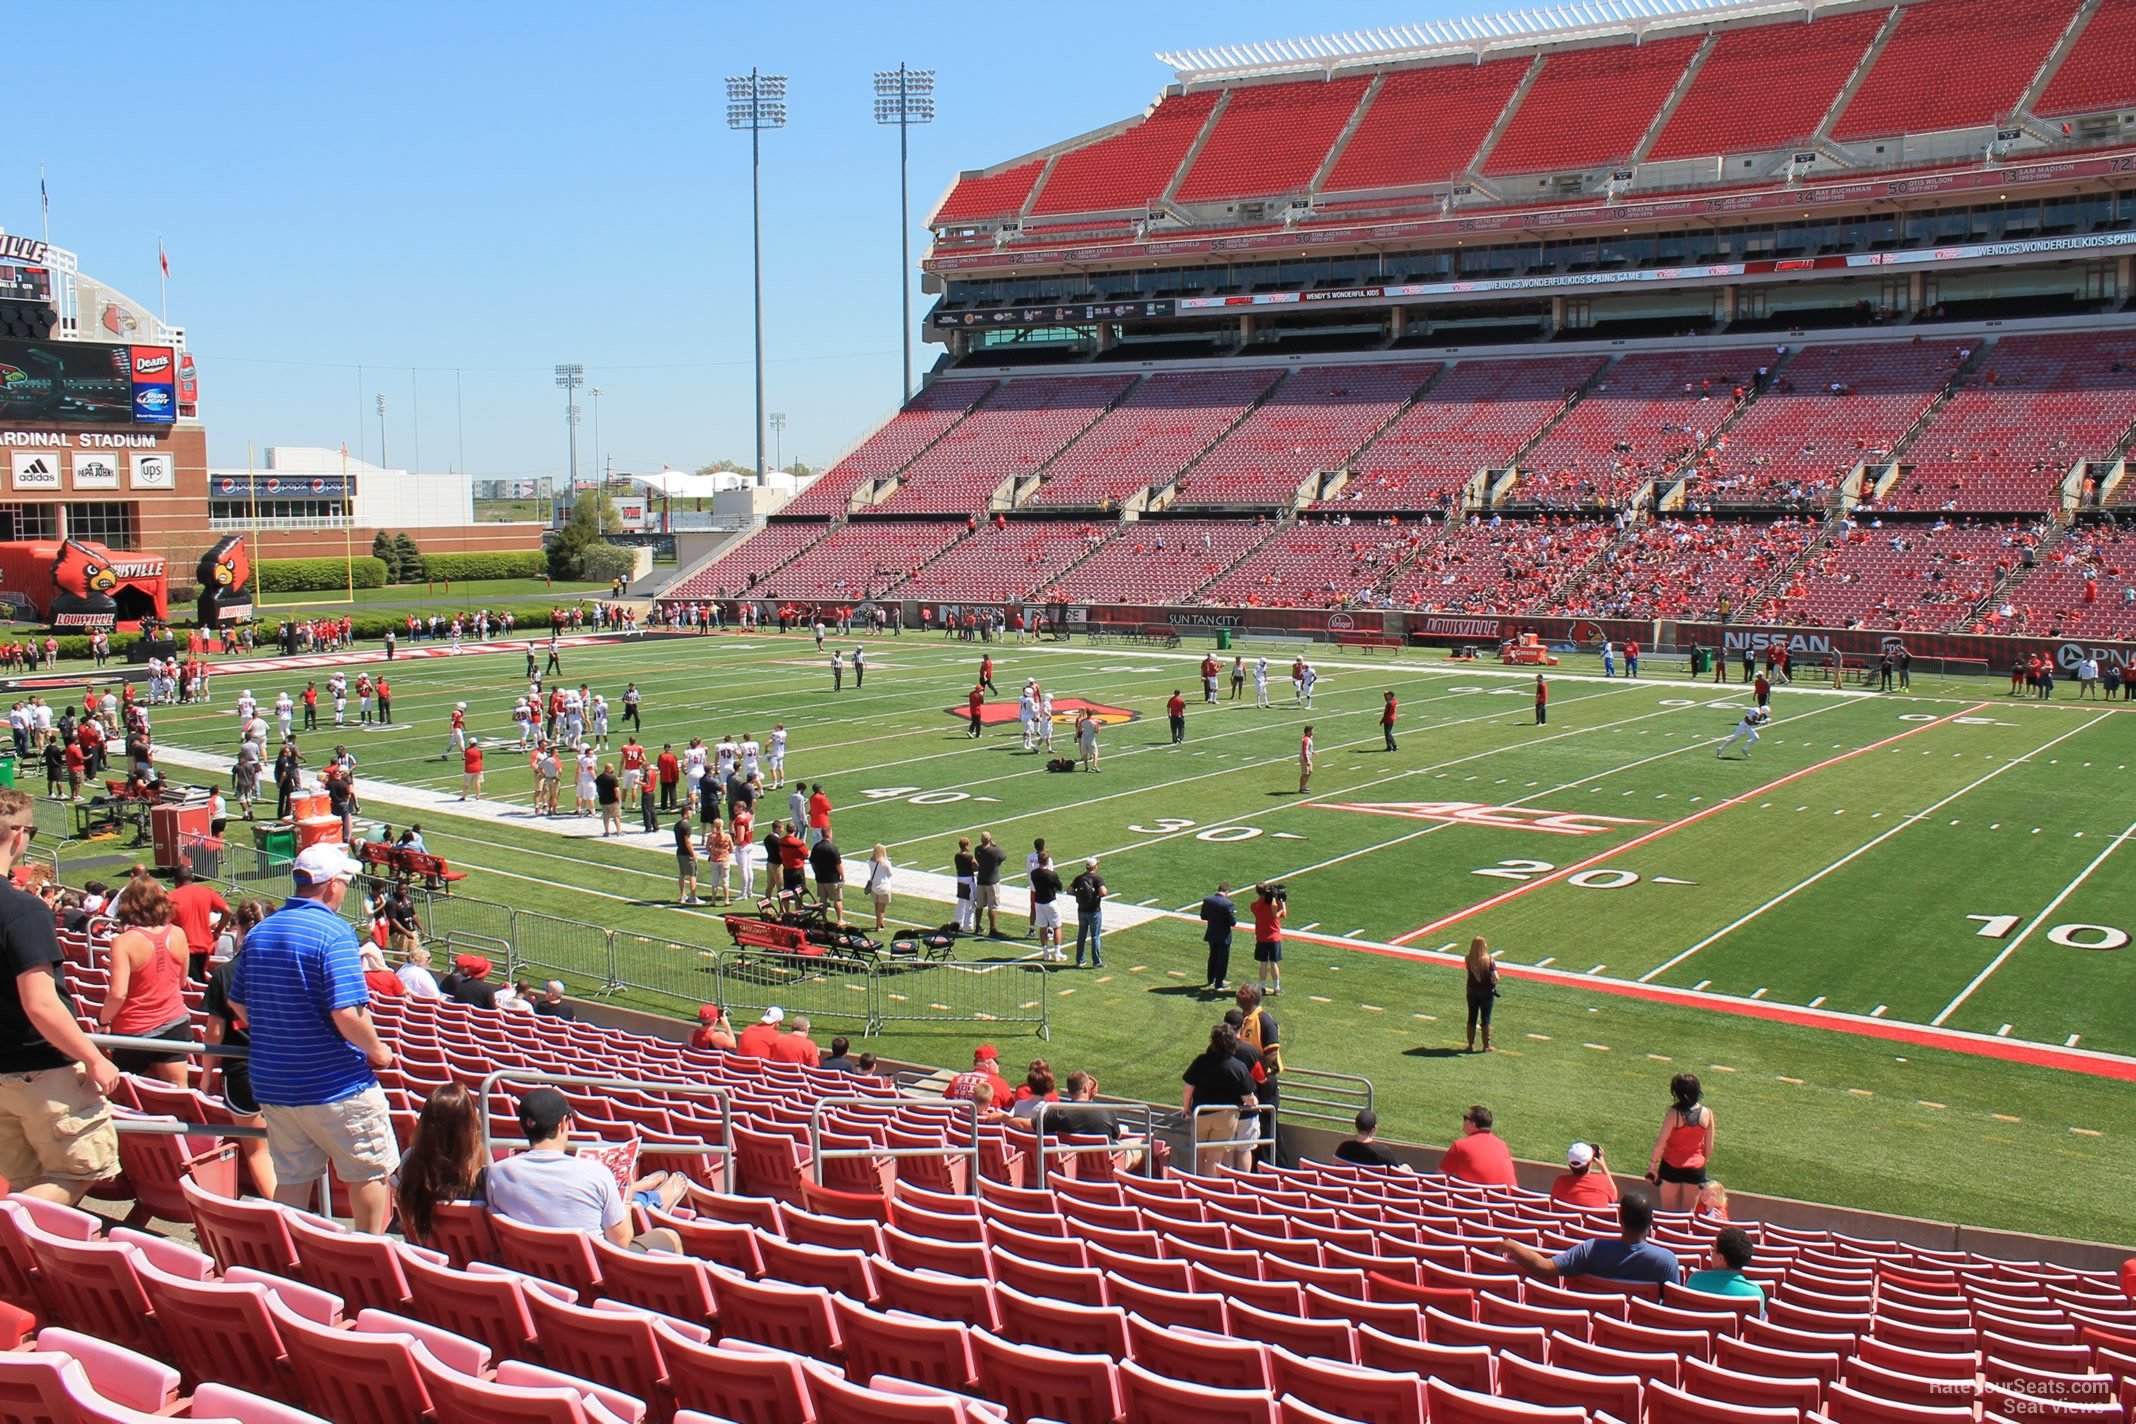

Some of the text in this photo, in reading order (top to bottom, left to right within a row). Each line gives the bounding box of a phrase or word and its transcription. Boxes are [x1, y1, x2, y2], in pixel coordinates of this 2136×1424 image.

[2037, 164, 2075, 174] MADISON
[2110, 158, 2130, 171] 72
[1926, 177, 1953, 186] WILSON
[2001, 171, 2018, 184] 13
[1831, 186, 1873, 195] BUCHANAN
[1888, 182, 1908, 194] 50
[1795, 191, 1814, 203] 34
[1627, 203, 1691, 213] DWAYNE WOODRUFF
[1706, 200, 1722, 211] 75
[1559, 210, 1597, 218] ARMSTRONG
[1612, 208, 1626, 219] 10
[1458, 222, 1474, 231] 56
[1522, 215, 1538, 226] 77
[1325, 230, 1351, 238] JACKSON
[1393, 224, 1418, 232] REDMAN
[1211, 239, 1226, 250] 55
[1296, 234, 1310, 244] 50
[0, 234, 47, 264] ILLE
[1978, 243, 2020, 256] WENDY'S
[2021, 238, 2079, 252] WONDERFUL
[2082, 236, 2105, 247] KIDS
[1008, 253, 1023, 264] 42
[1064, 251, 1078, 261] 26
[925, 261, 936, 271] 16
[1487, 272, 1641, 290] WENDY'S WONDERFUL KIDS SPRING GAME
[1306, 288, 1380, 300] WENDY'S WONDERFUL KIDS
[135, 355, 169, 371] Dean's
[80, 433, 156, 448] STADIUM
[19, 472, 55, 482] adidas
[142, 464, 162, 480] ups
[54, 613, 115, 626] LOUISVILLE
[1168, 614, 1241, 626] SUN TAN CITY
[1331, 616, 1352, 629] Kroger
[1426, 618, 1499, 637] LOUISVILLE
[1725, 631, 1829, 653] NISSAN
[1127, 817, 1265, 843] 30
[1470, 858, 1642, 889] 20
[1965, 914, 2132, 950] 10
